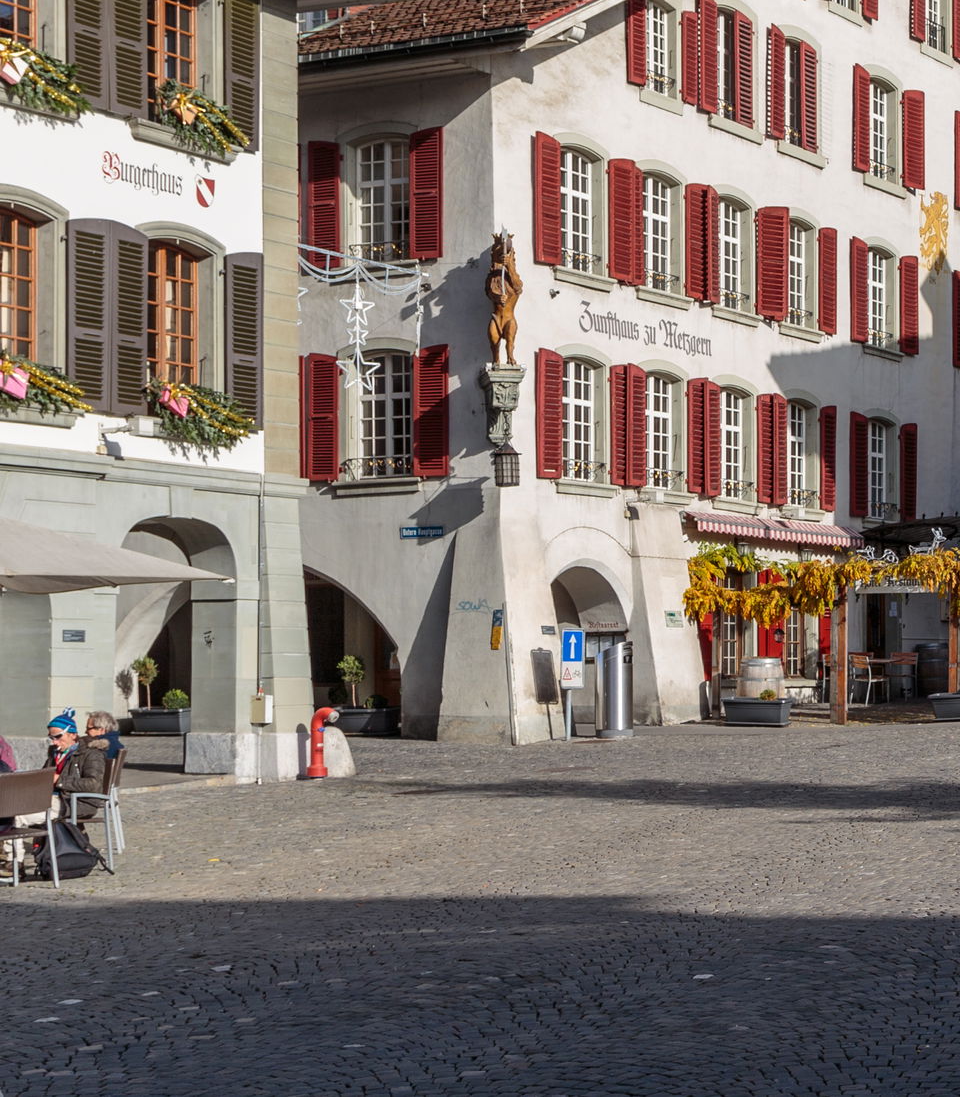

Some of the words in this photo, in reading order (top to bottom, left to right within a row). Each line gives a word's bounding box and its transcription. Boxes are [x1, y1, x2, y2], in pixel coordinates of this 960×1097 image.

[102, 150, 183, 197] Burgerhaus
[579, 300, 640, 341] Zunfthaus
[643, 324, 656, 346] zu
[659, 319, 713, 357] Metzgern
